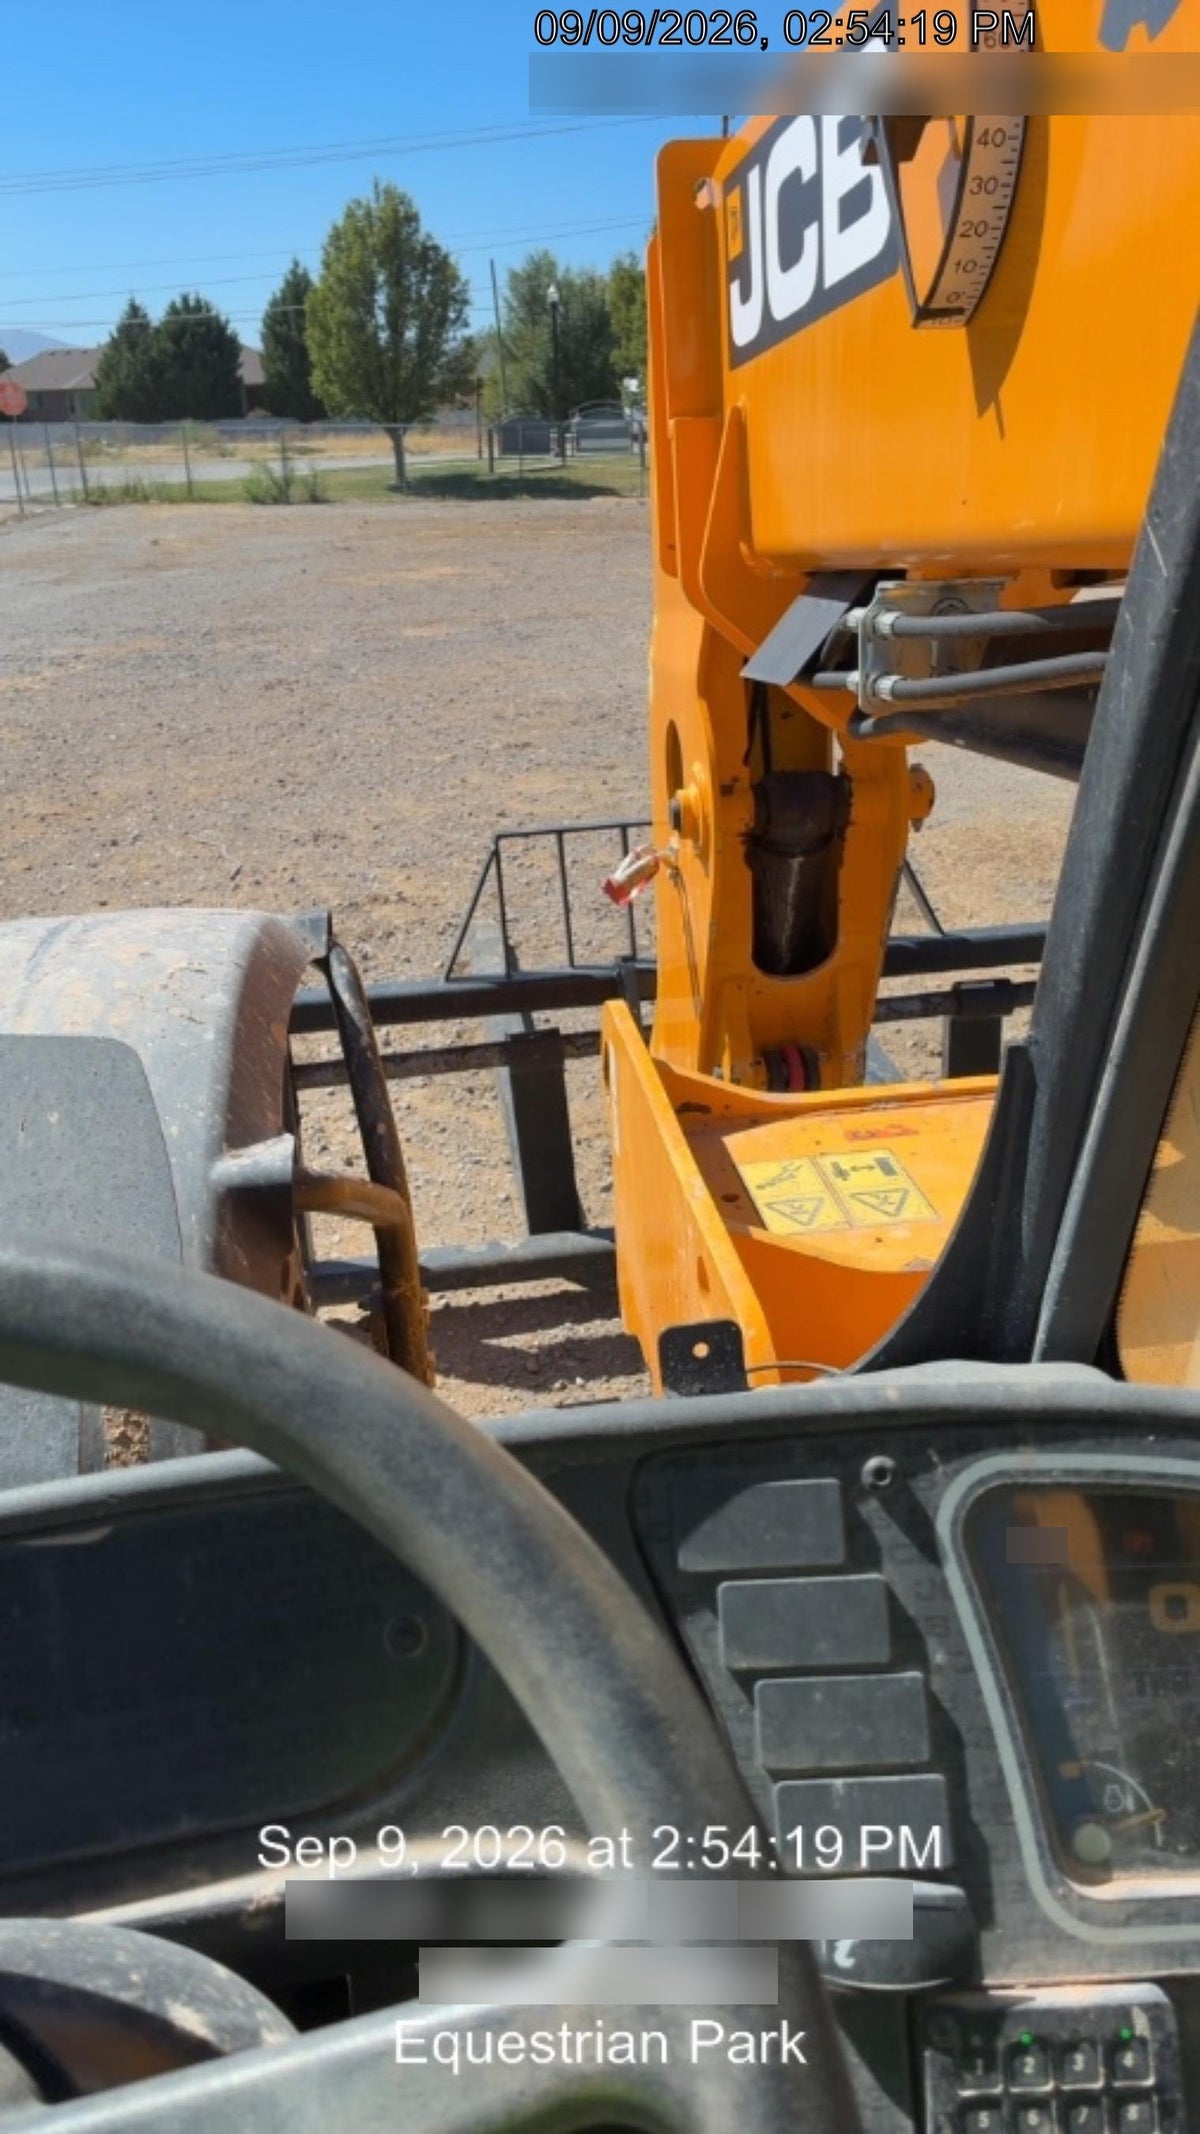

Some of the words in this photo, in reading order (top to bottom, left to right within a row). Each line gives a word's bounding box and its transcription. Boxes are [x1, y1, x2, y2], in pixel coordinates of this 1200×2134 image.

[977, 127, 1006, 148] 40
[729, 38, 891, 347] JCB
[969, 175, 999, 195] 30
[959, 220, 988, 238] 20
[954, 260, 977, 274] 10
[1023, 2056, 1036, 2074] 2
[1072, 2053, 1086, 2071] 3
[1122, 2050, 1135, 2068] 4
[978, 2110, 991, 2129] 5
[1027, 2108, 1040, 2126] 6
[1077, 2105, 1089, 2124] 7
[1126, 2102, 1139, 2121] 8
